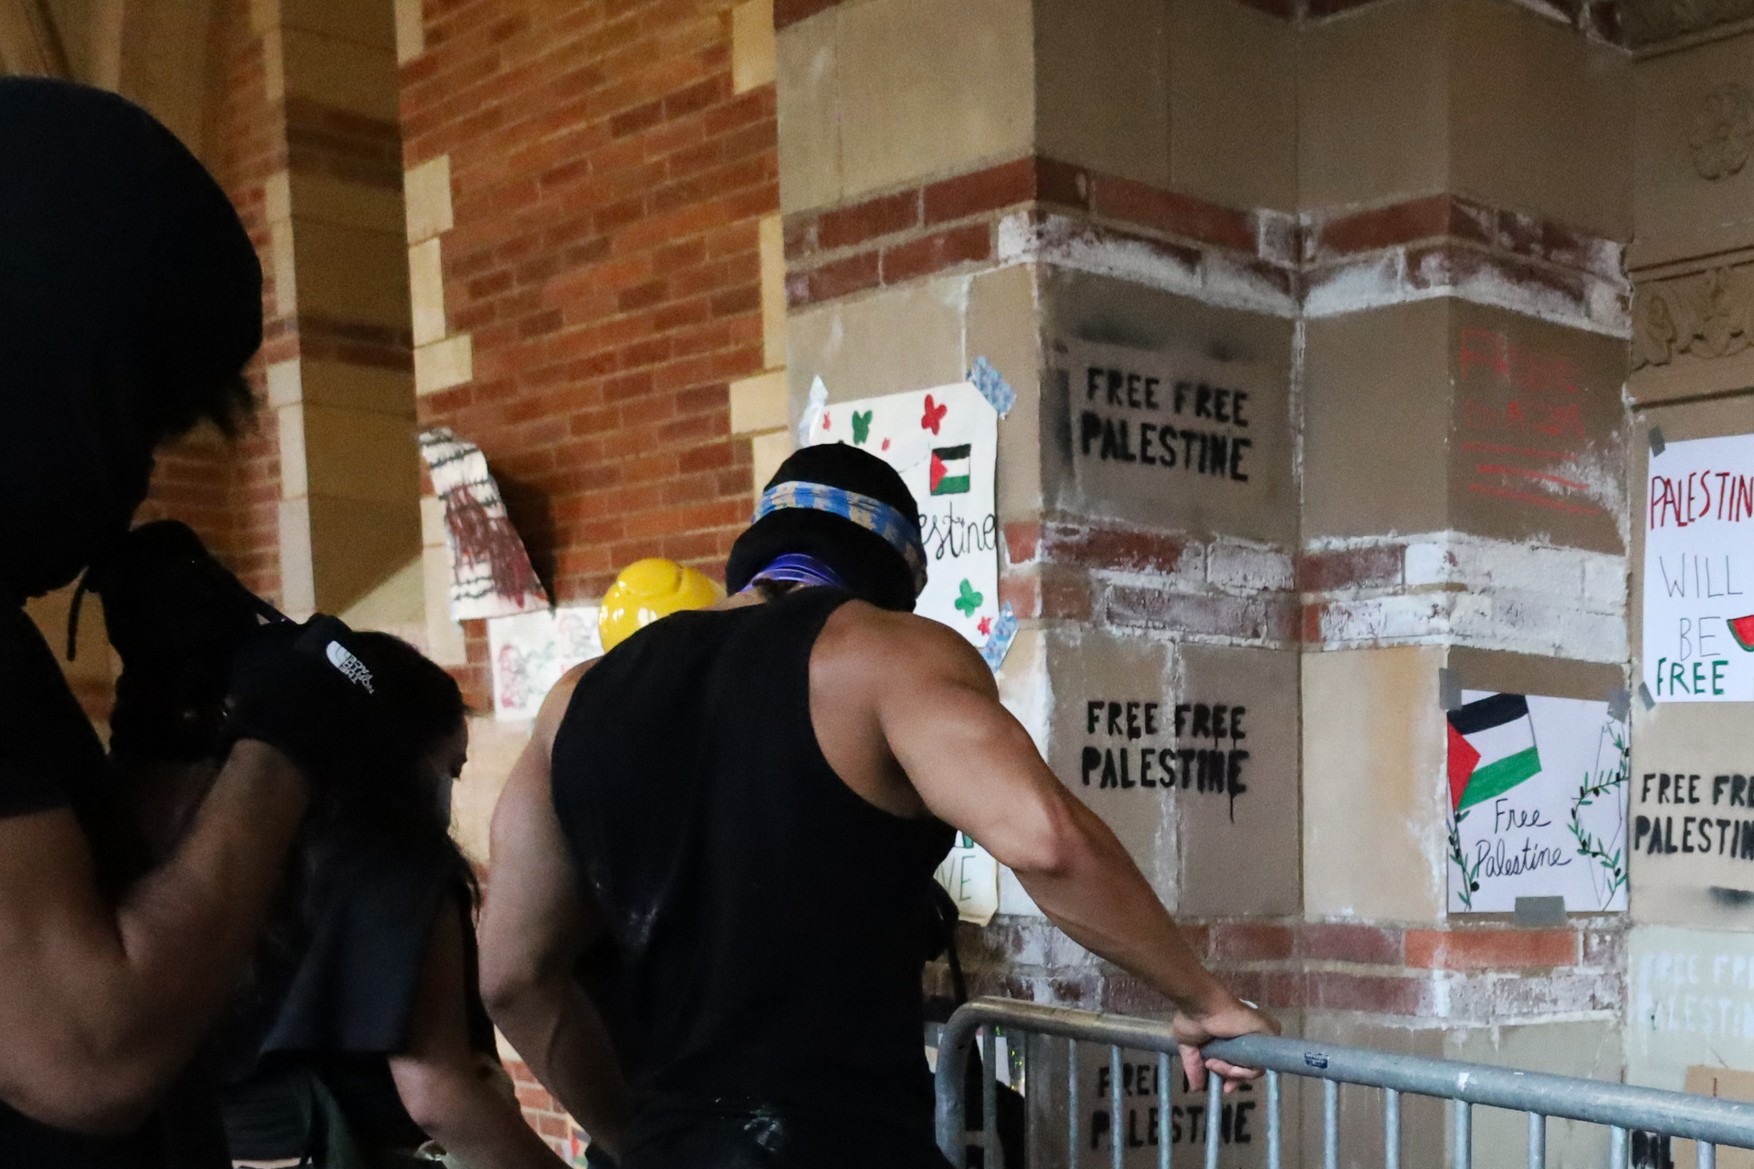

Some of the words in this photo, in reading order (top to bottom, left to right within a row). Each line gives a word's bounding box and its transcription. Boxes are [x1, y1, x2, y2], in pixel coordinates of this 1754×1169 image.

[1087, 366, 1160, 411] FREE
[1172, 380, 1249, 427] FREE
[1081, 410, 1253, 482] PALESTINE
[1659, 553, 1744, 598] WILL
[1680, 616, 1721, 661] BE
[1656, 657, 1729, 696] FREE
[1087, 701, 1159, 740] FREE
[1174, 703, 1247, 742] FREE
[1081, 746, 1250, 798] PALESTINE
[1641, 773, 1702, 804] FREE
[1495, 798, 1552, 834] Free
[1475, 837, 1572, 878] Palestine
[1097, 1062, 1160, 1098] FRE
